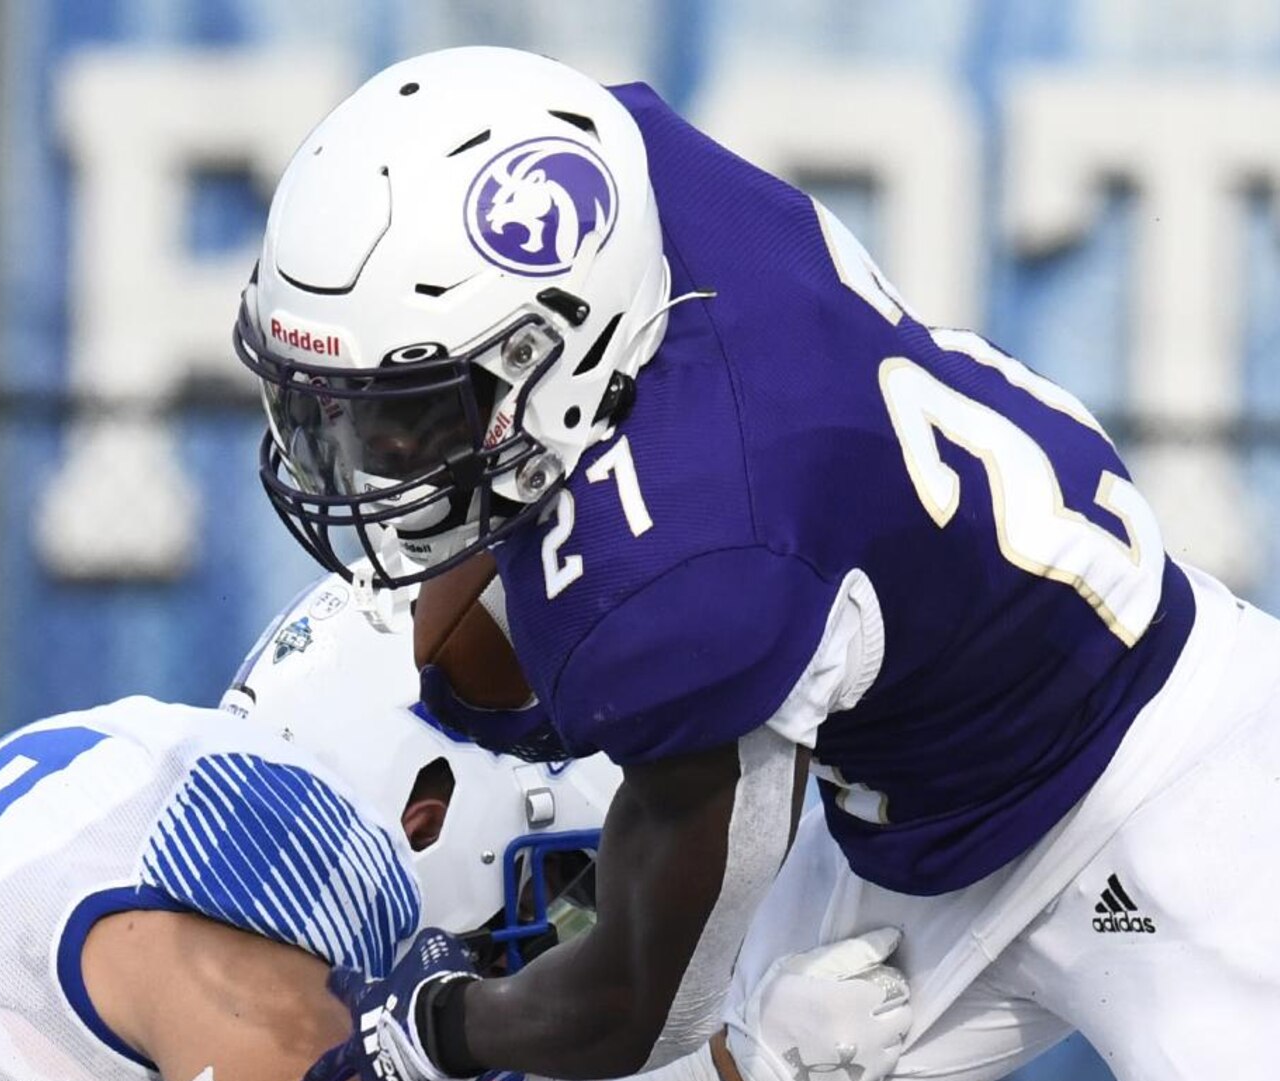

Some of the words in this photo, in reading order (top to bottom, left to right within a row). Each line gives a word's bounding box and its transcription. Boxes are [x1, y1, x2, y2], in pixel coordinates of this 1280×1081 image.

[271, 319, 340, 357] Riddell
[537, 434, 655, 601] 27
[1092, 910, 1156, 934] adidas
